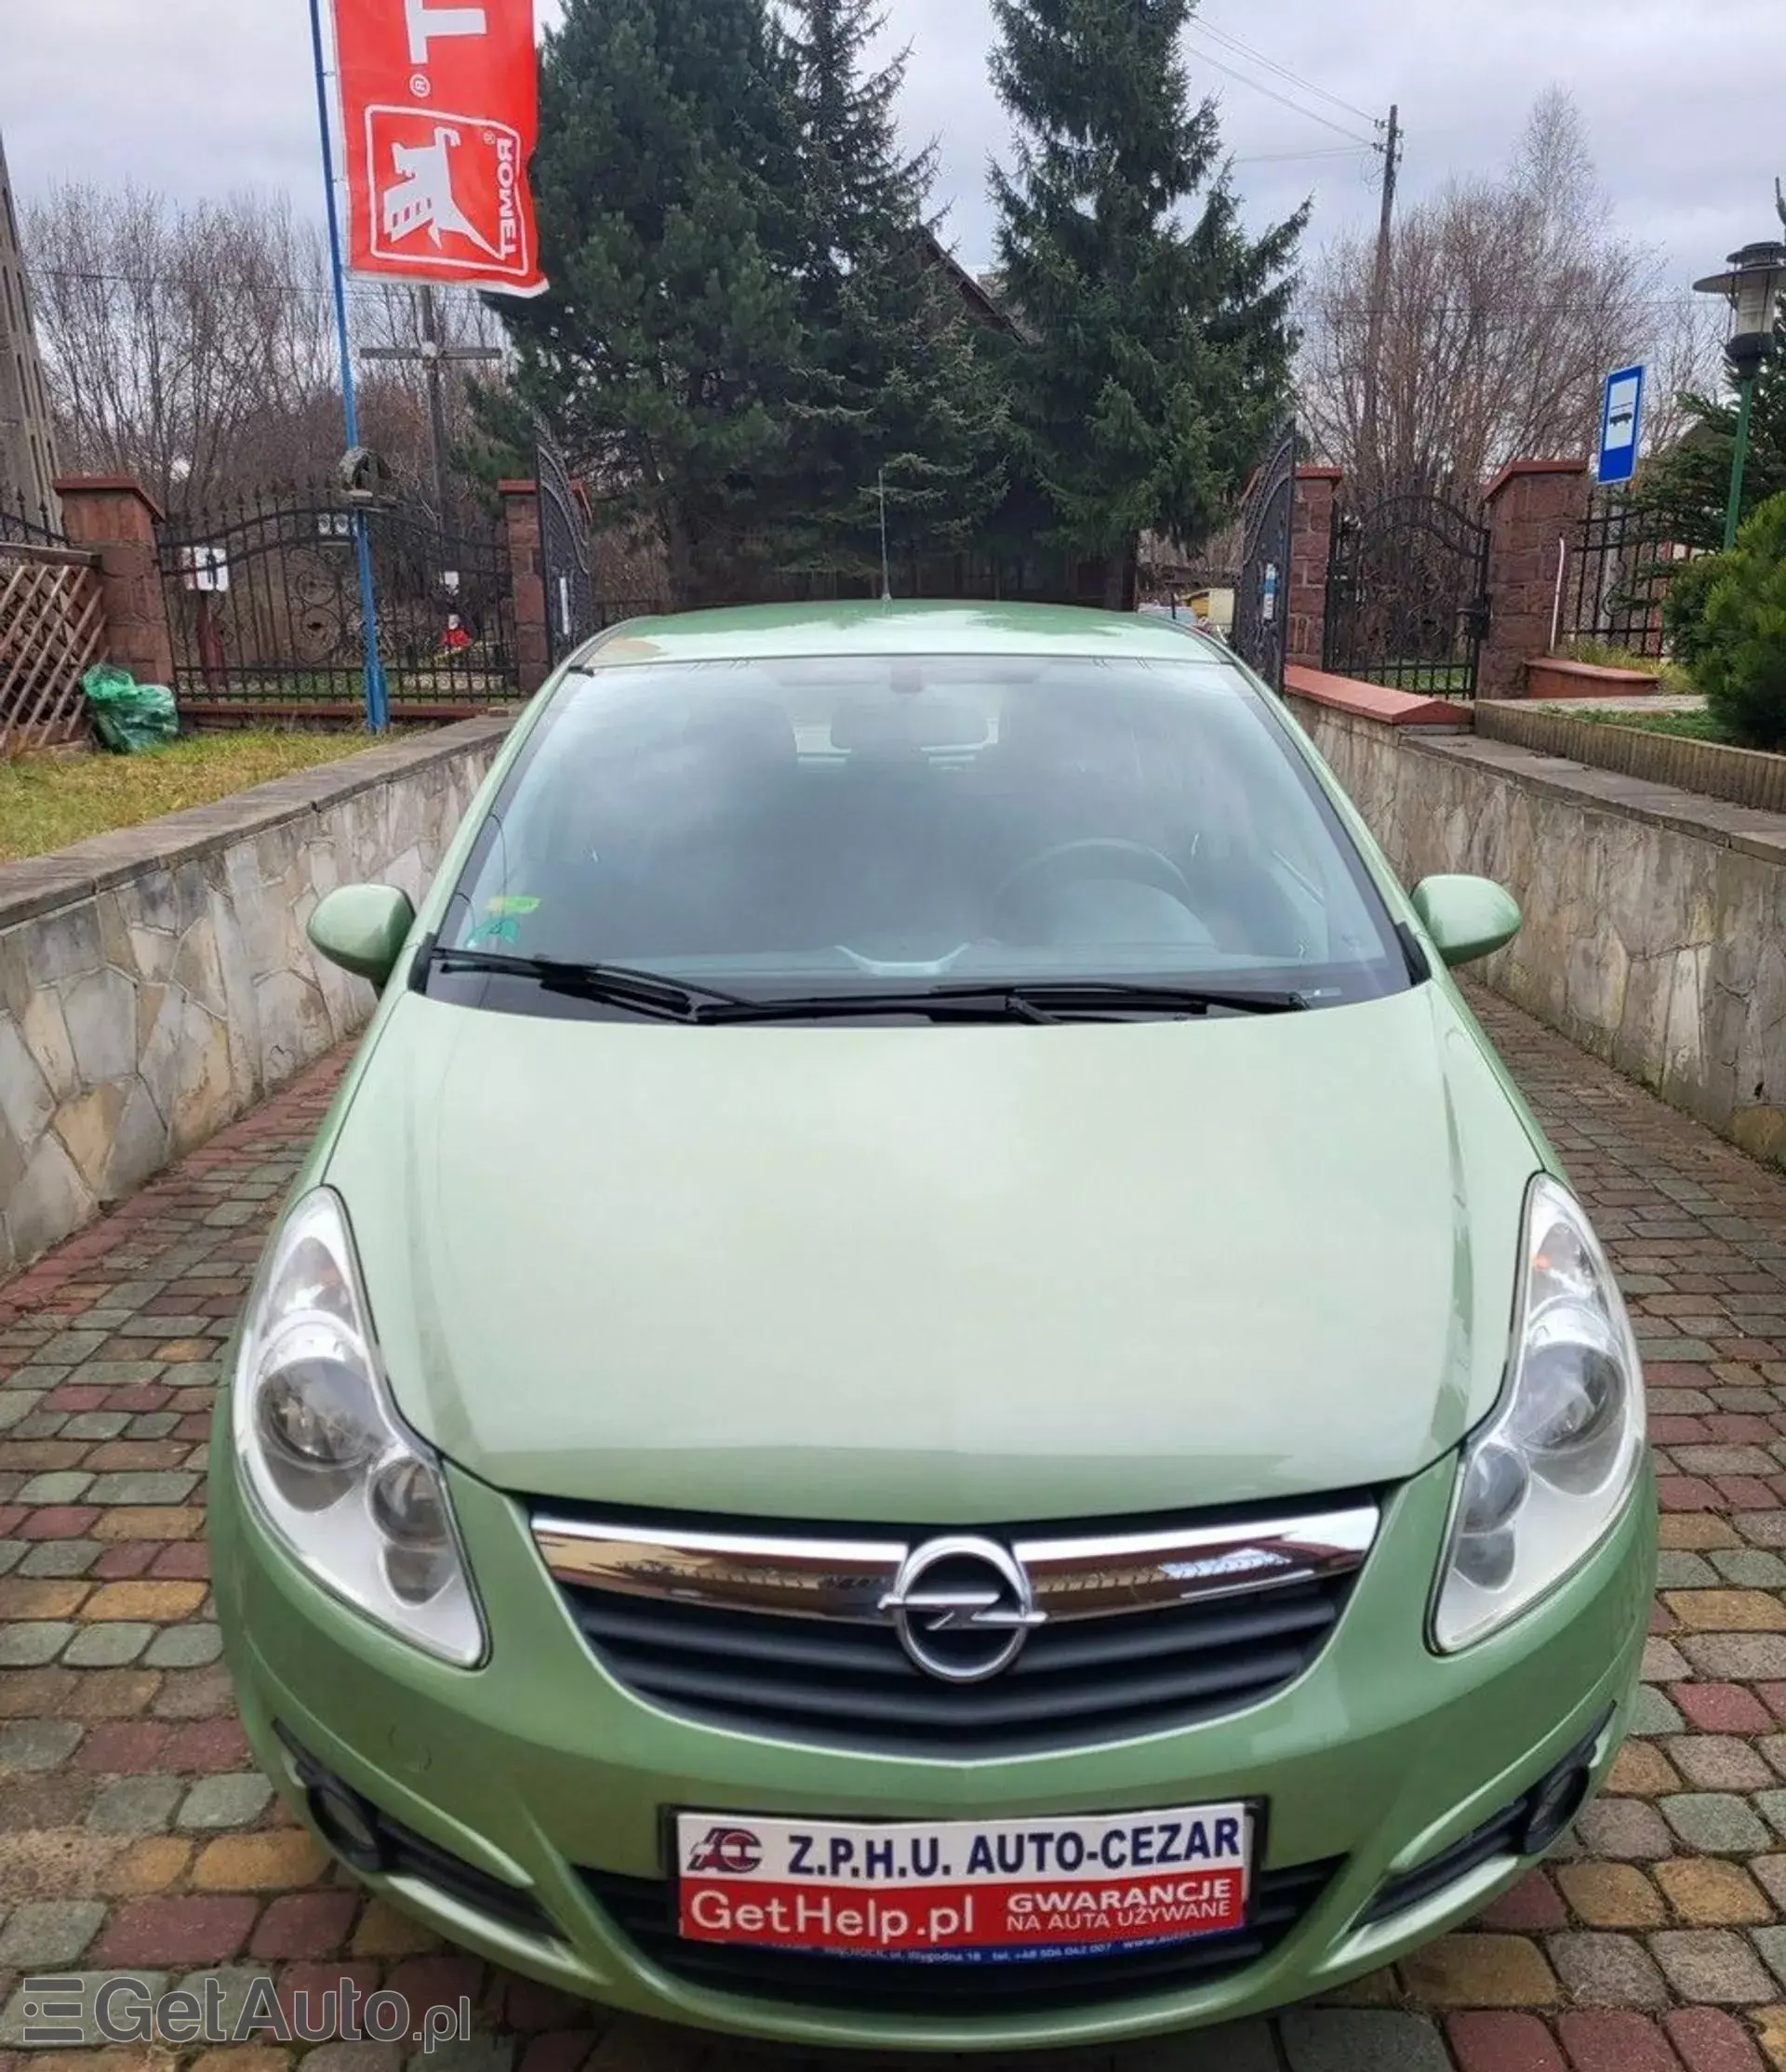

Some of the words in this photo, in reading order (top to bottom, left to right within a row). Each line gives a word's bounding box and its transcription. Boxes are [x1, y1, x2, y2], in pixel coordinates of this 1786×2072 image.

[788, 1835, 951, 1879] Z.P.H.U.
[966, 1817, 1240, 1875] AUTO-CEZAR
[691, 1890, 973, 1944] GetHelp.pl
[1006, 1879, 1232, 1913] GWARANCJE
[1006, 1914, 1041, 1932] NA
[1047, 1910, 1111, 1931] AUTA
[1118, 1899, 1231, 1926] UŻYWANE
